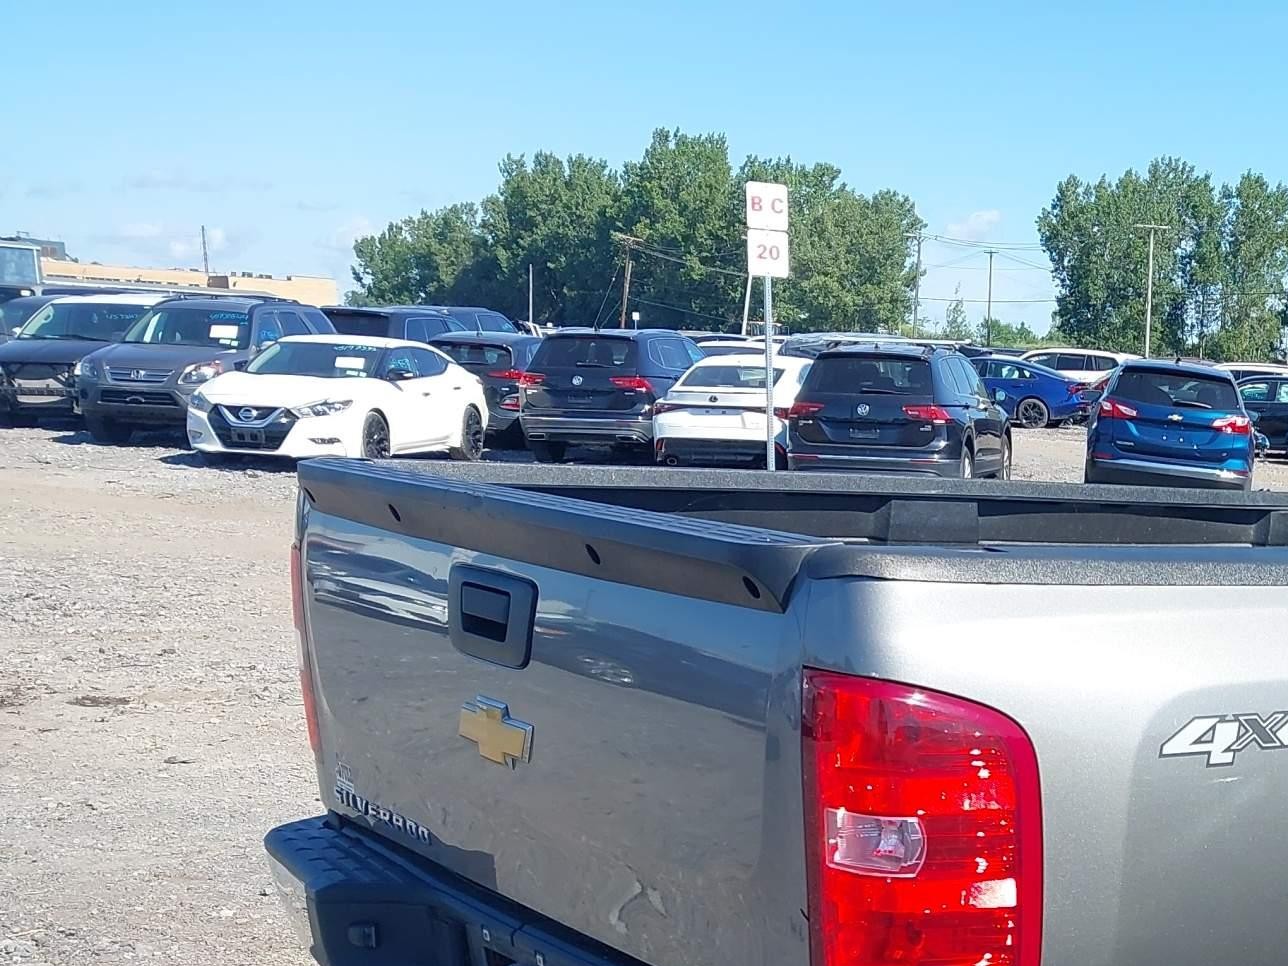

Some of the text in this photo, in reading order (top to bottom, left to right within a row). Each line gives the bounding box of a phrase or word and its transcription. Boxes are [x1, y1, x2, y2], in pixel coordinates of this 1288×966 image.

[751, 196, 784, 214] B C
[756, 244, 780, 260] 20
[334, 787, 433, 846] SILVERADO
